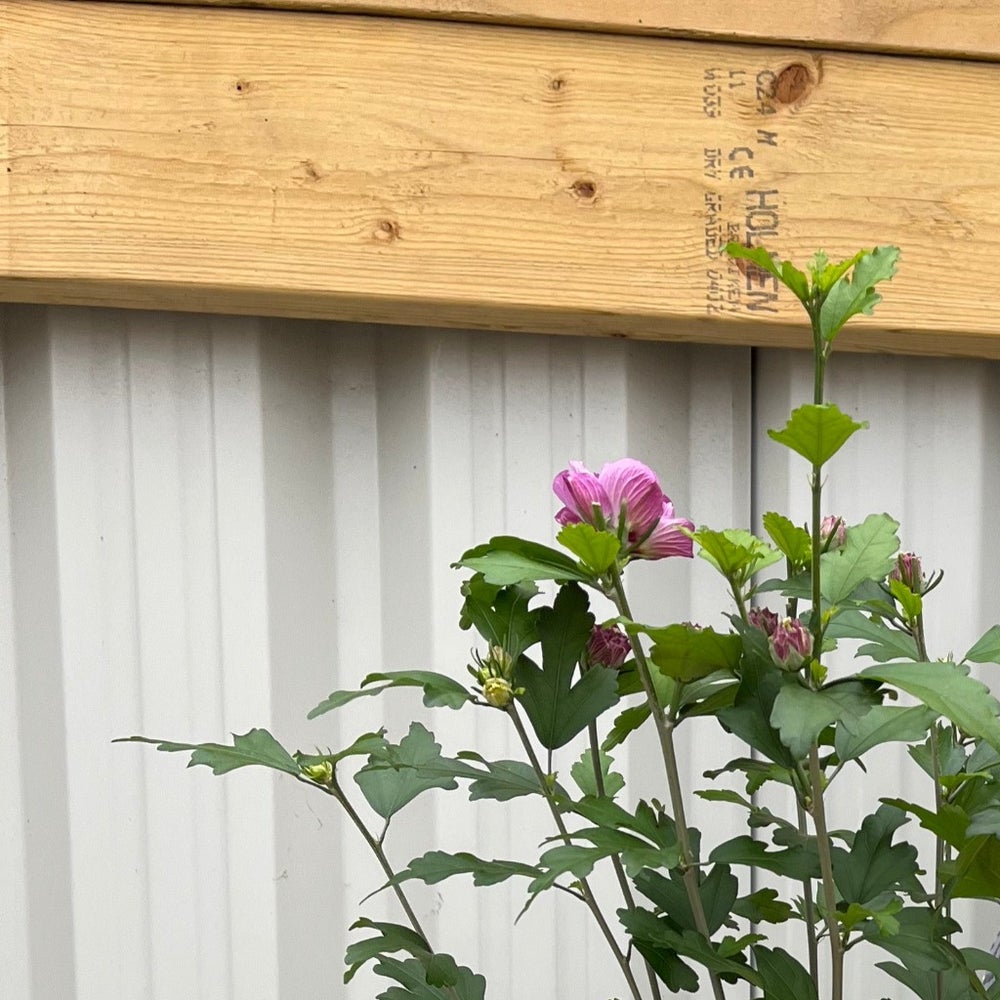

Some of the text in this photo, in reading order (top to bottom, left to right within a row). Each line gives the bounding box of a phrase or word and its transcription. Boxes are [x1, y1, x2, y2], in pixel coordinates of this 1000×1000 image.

[756, 70, 778, 147] C24 M
[728, 147, 755, 180] CE
